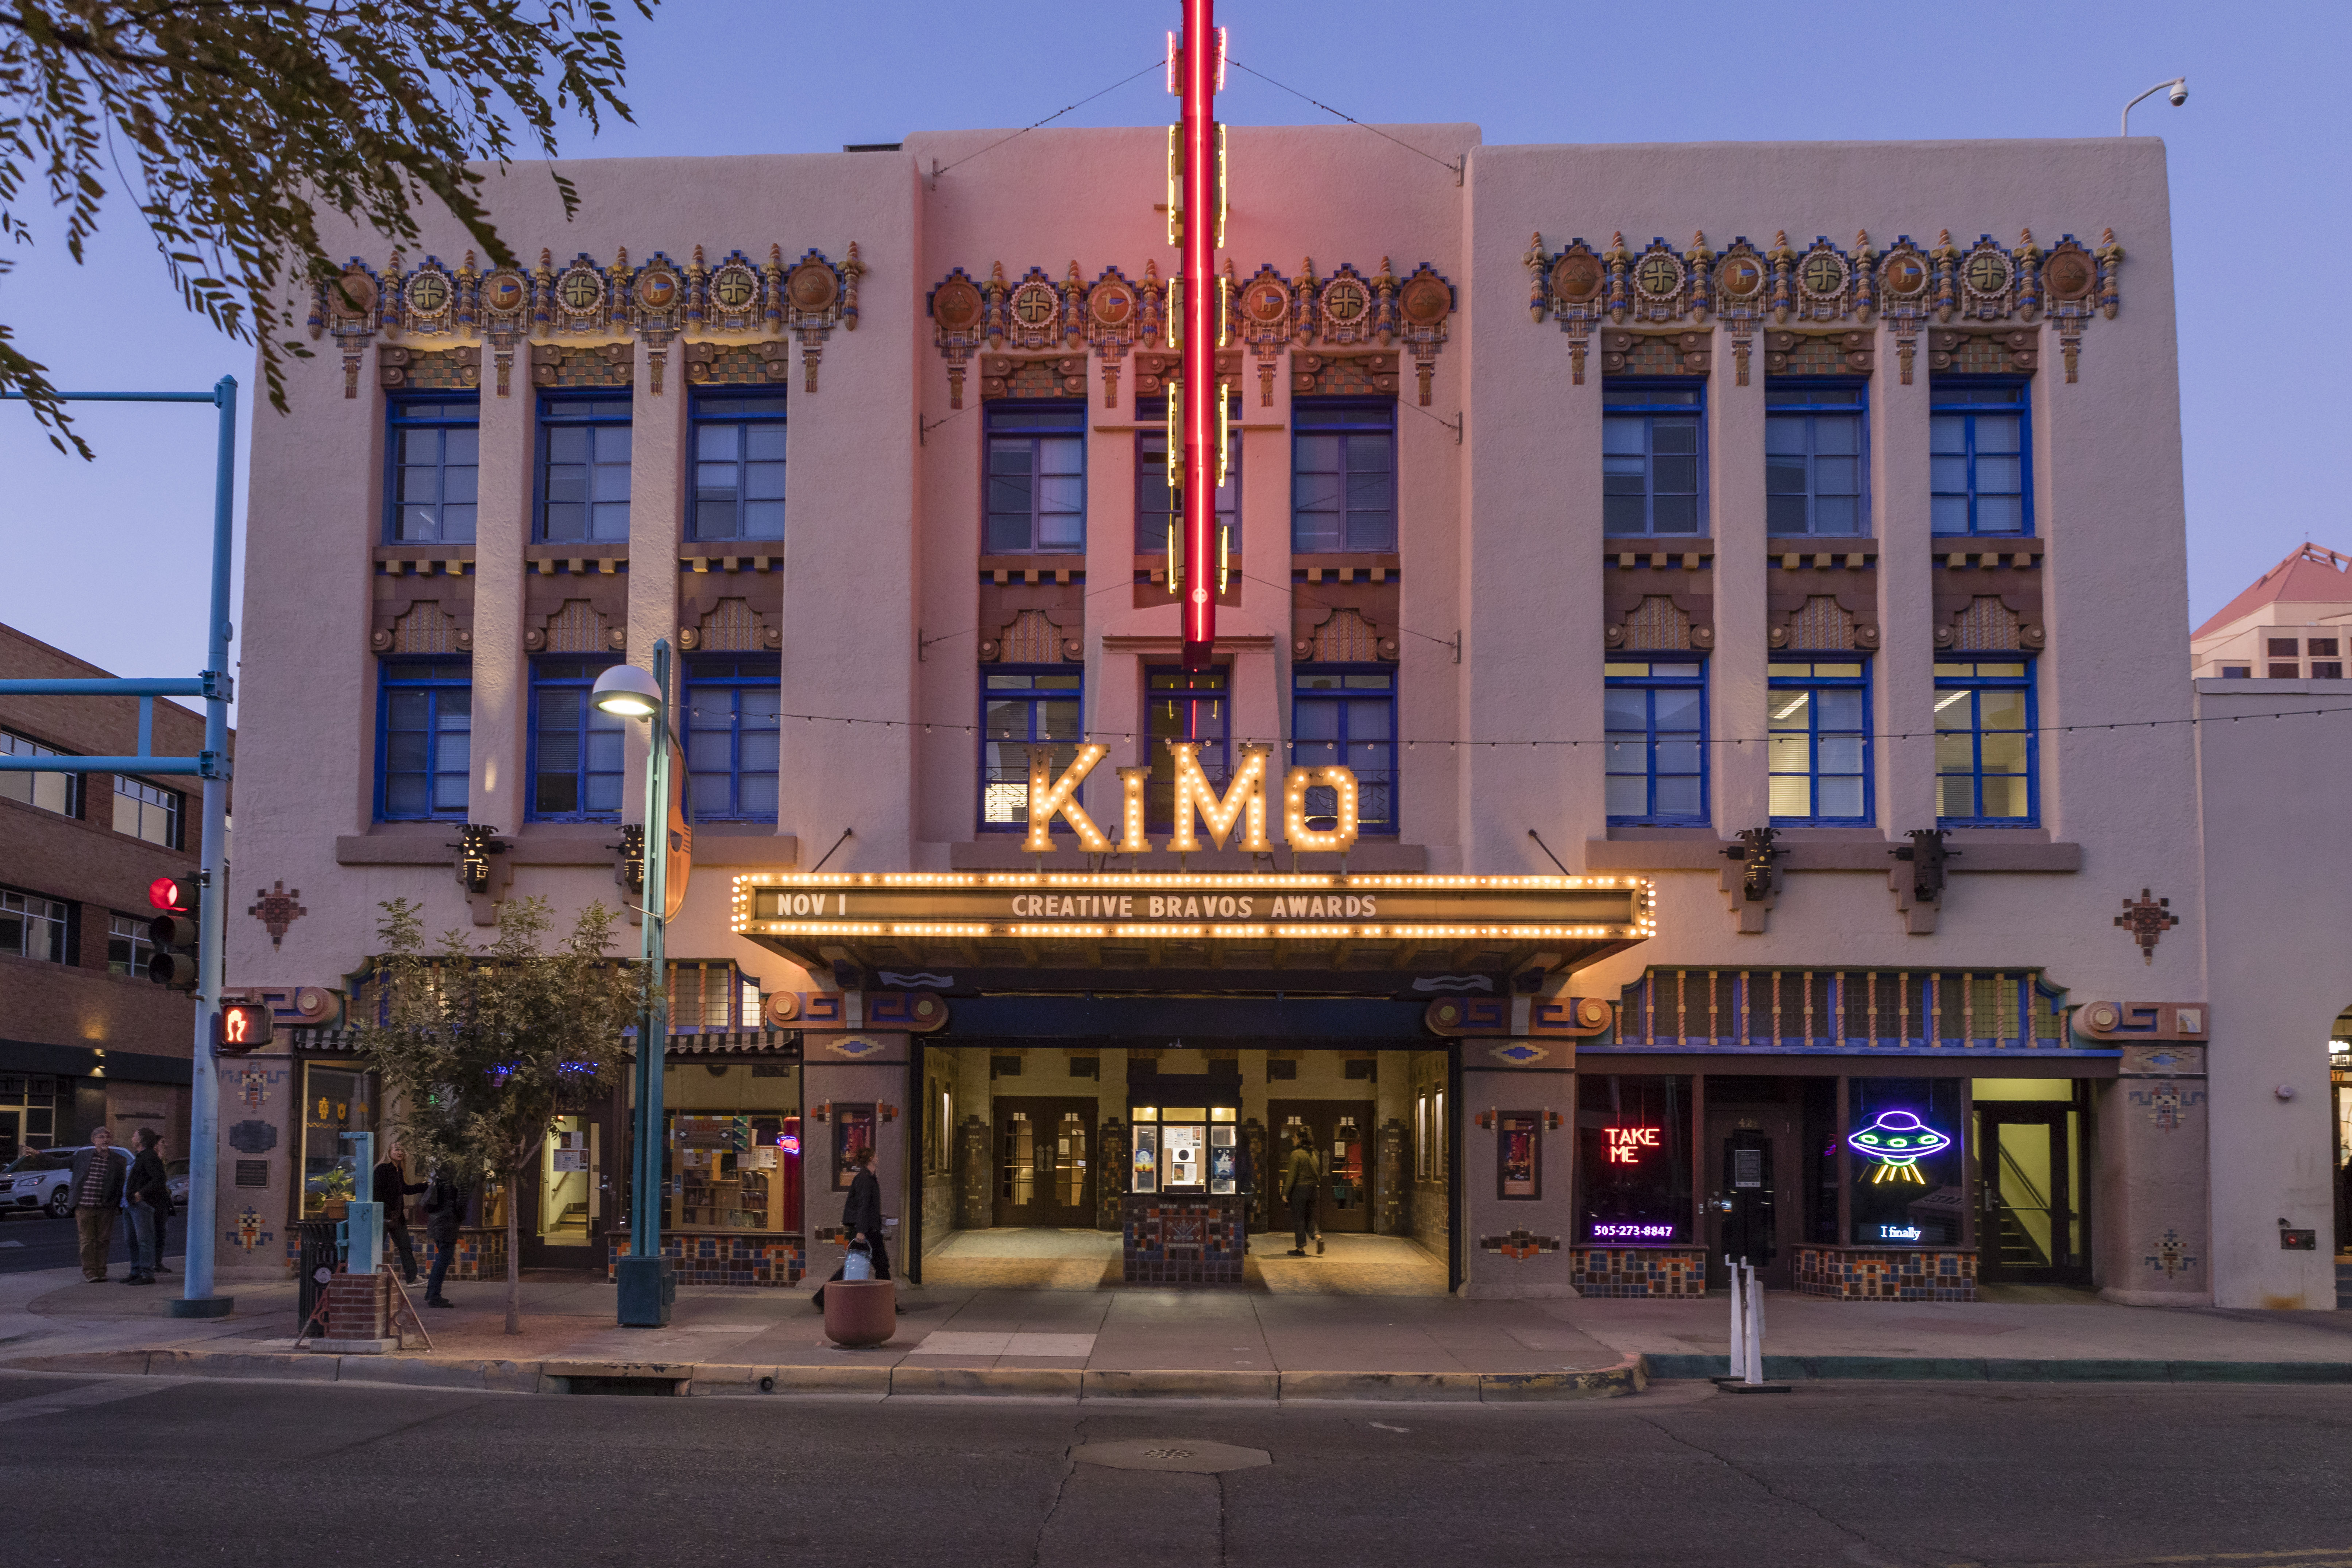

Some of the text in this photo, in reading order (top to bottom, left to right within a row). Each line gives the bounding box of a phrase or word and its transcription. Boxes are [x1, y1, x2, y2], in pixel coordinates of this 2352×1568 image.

[777, 894, 826, 916] NOV
[1012, 895, 1132, 917] CREATIVE
[1150, 895, 1254, 918] BRAVOS
[1272, 895, 1377, 918] AWARDS
[2331, 1071, 2344, 1081] 17
[1604, 1128, 1660, 1146] TAKE
[1611, 1146, 1639, 1163] ME
[1594, 1225, 1673, 1236] 505-273-8847
[1880, 1226, 1922, 1241] I finally
